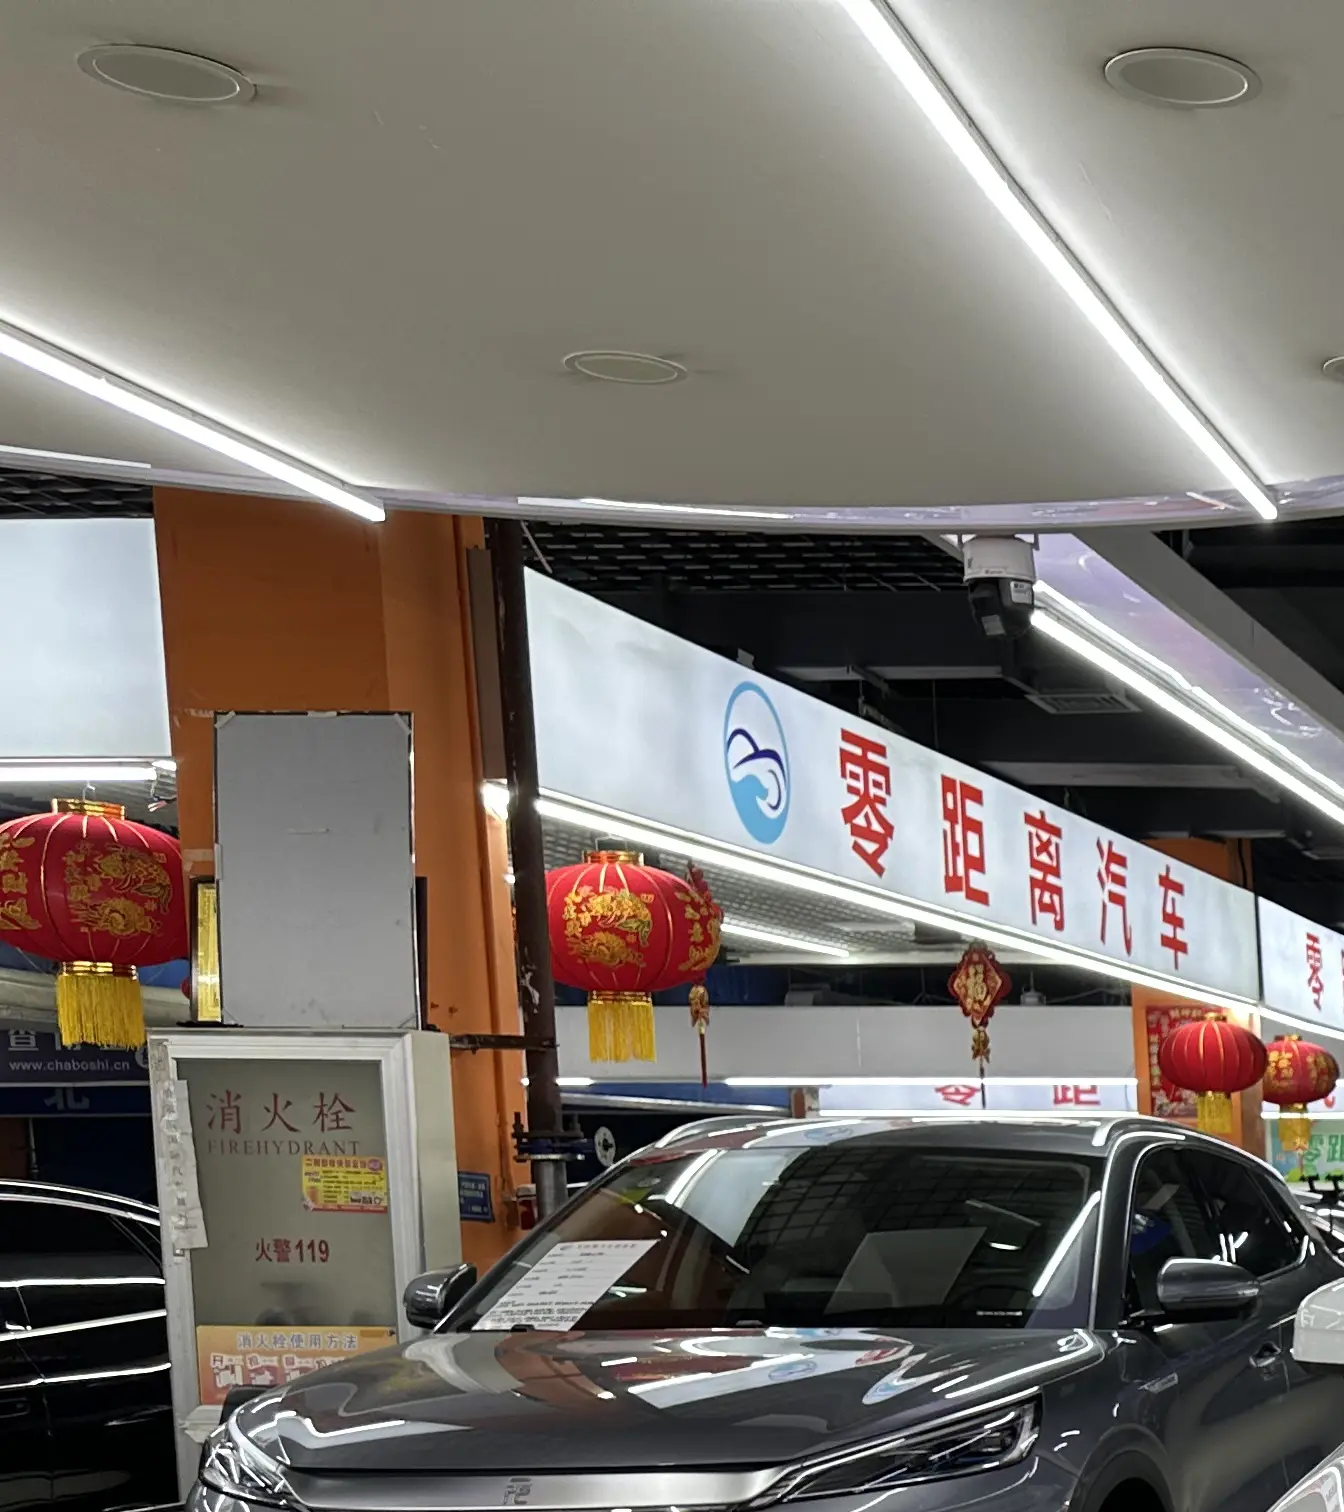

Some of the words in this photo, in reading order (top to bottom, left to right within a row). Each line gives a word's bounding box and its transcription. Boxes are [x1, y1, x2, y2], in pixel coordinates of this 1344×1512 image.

[839, 728, 1189, 970] 零距离汽车
[8, 1059, 130, 1072] www.chaboshi.cn
[206, 1089, 356, 1134] 消火栓
[255, 1238, 330, 1263] 火警119
[237, 1331, 358, 1350] 消火栓使用方法
